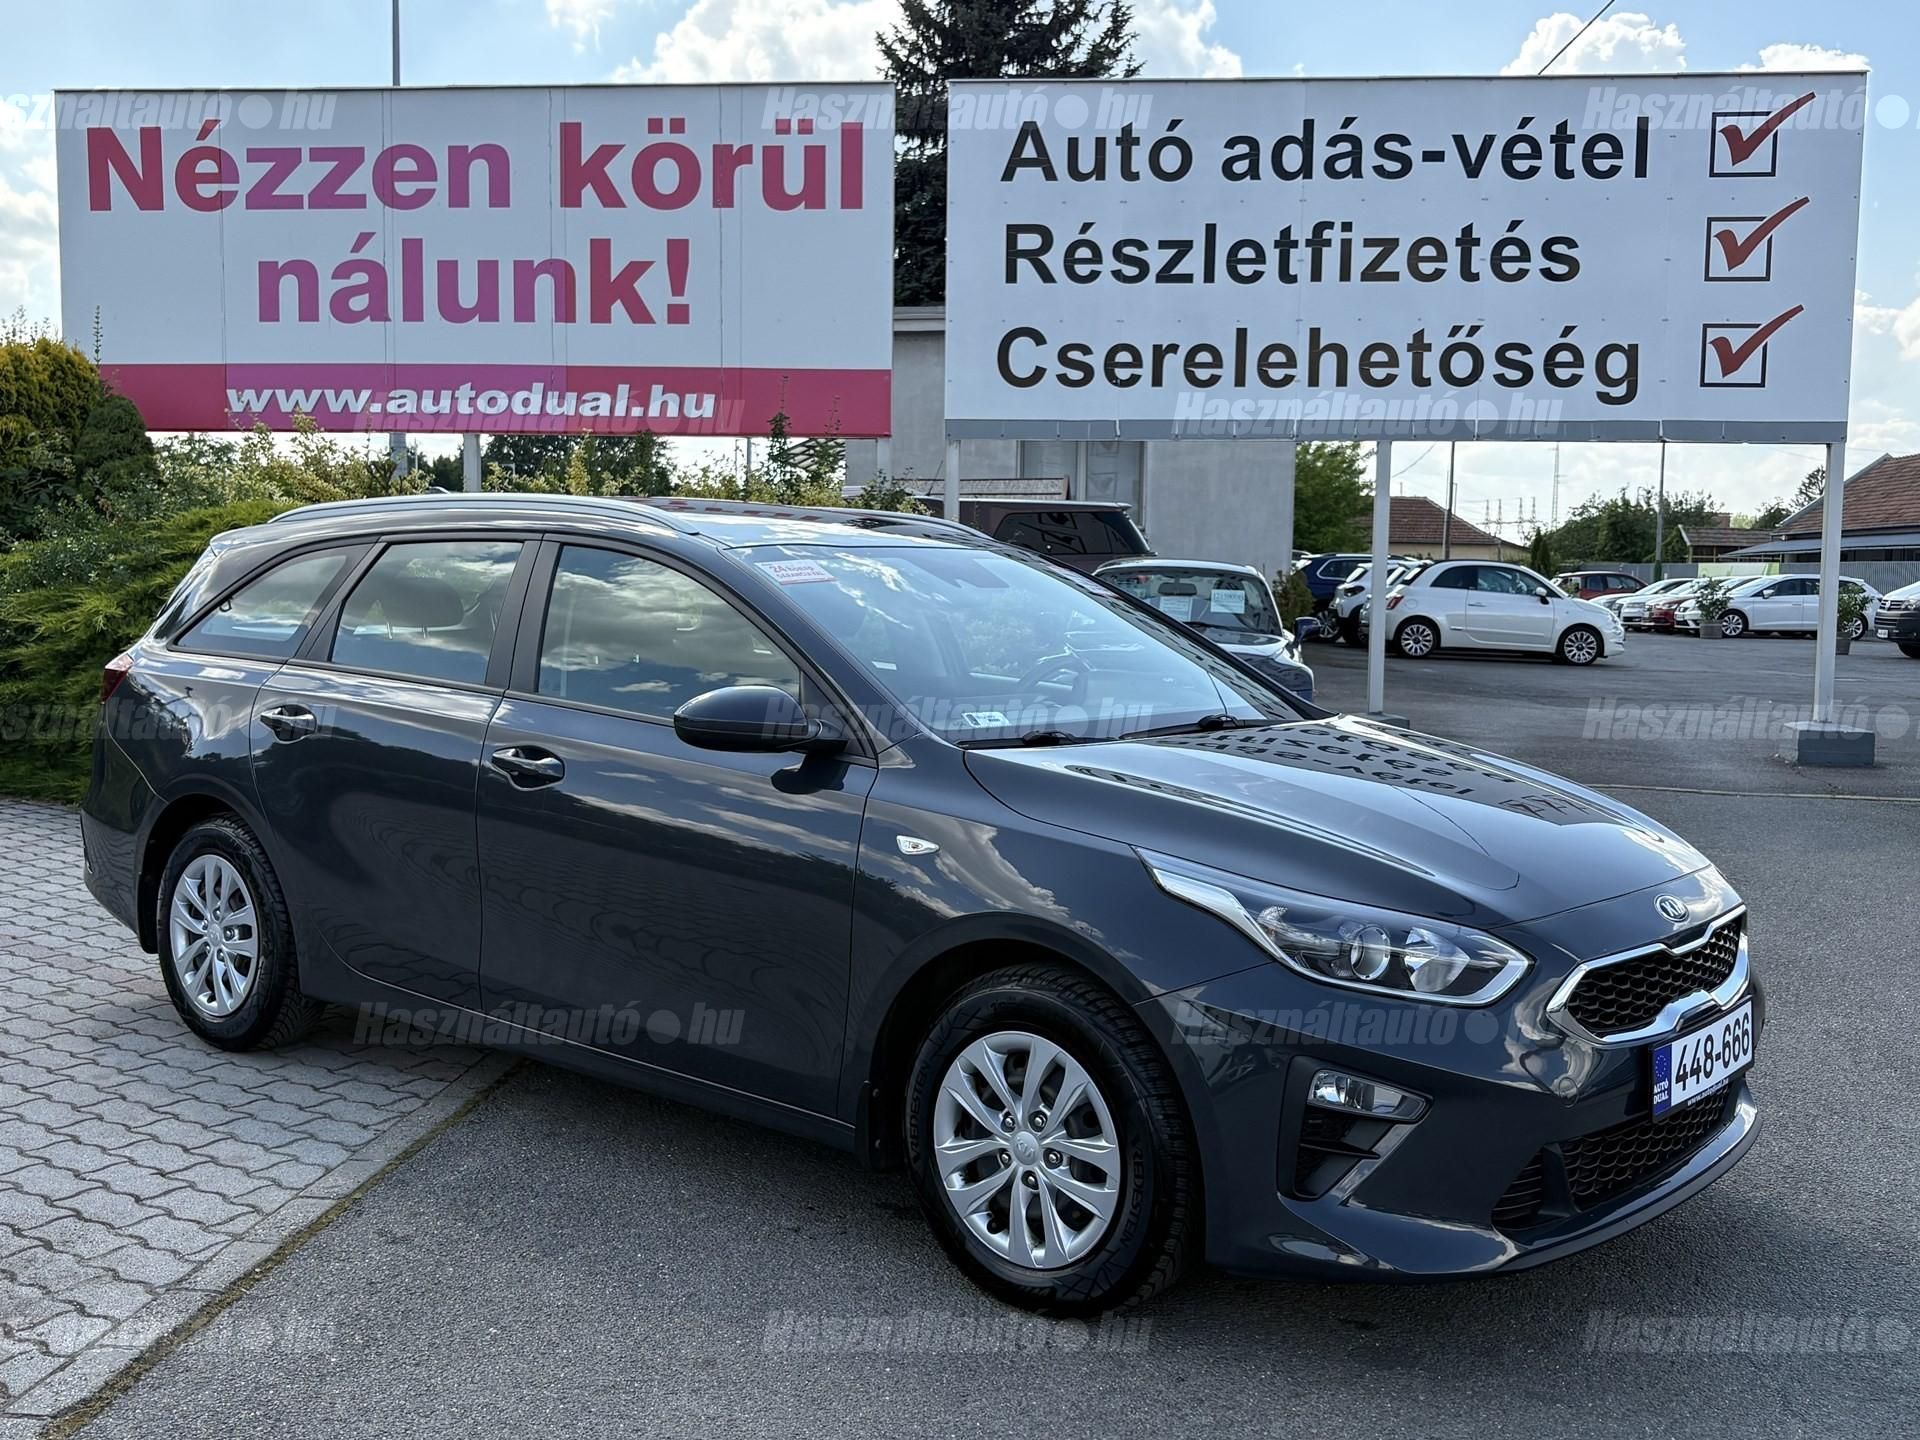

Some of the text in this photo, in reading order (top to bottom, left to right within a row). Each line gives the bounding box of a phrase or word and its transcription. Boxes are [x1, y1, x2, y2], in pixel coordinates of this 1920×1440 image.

[88, 118, 863, 212] Nézzen körül
[1000, 116, 1649, 182] Autó adás-vétel
[258, 231, 690, 325] nálunk!
[1005, 219, 1581, 285] Részletfizetés
[226, 382, 716, 419] www.autodual.hu
[997, 325, 1640, 406] Cserelehetőség
[1674, 1011, 1751, 1092] 448-666
